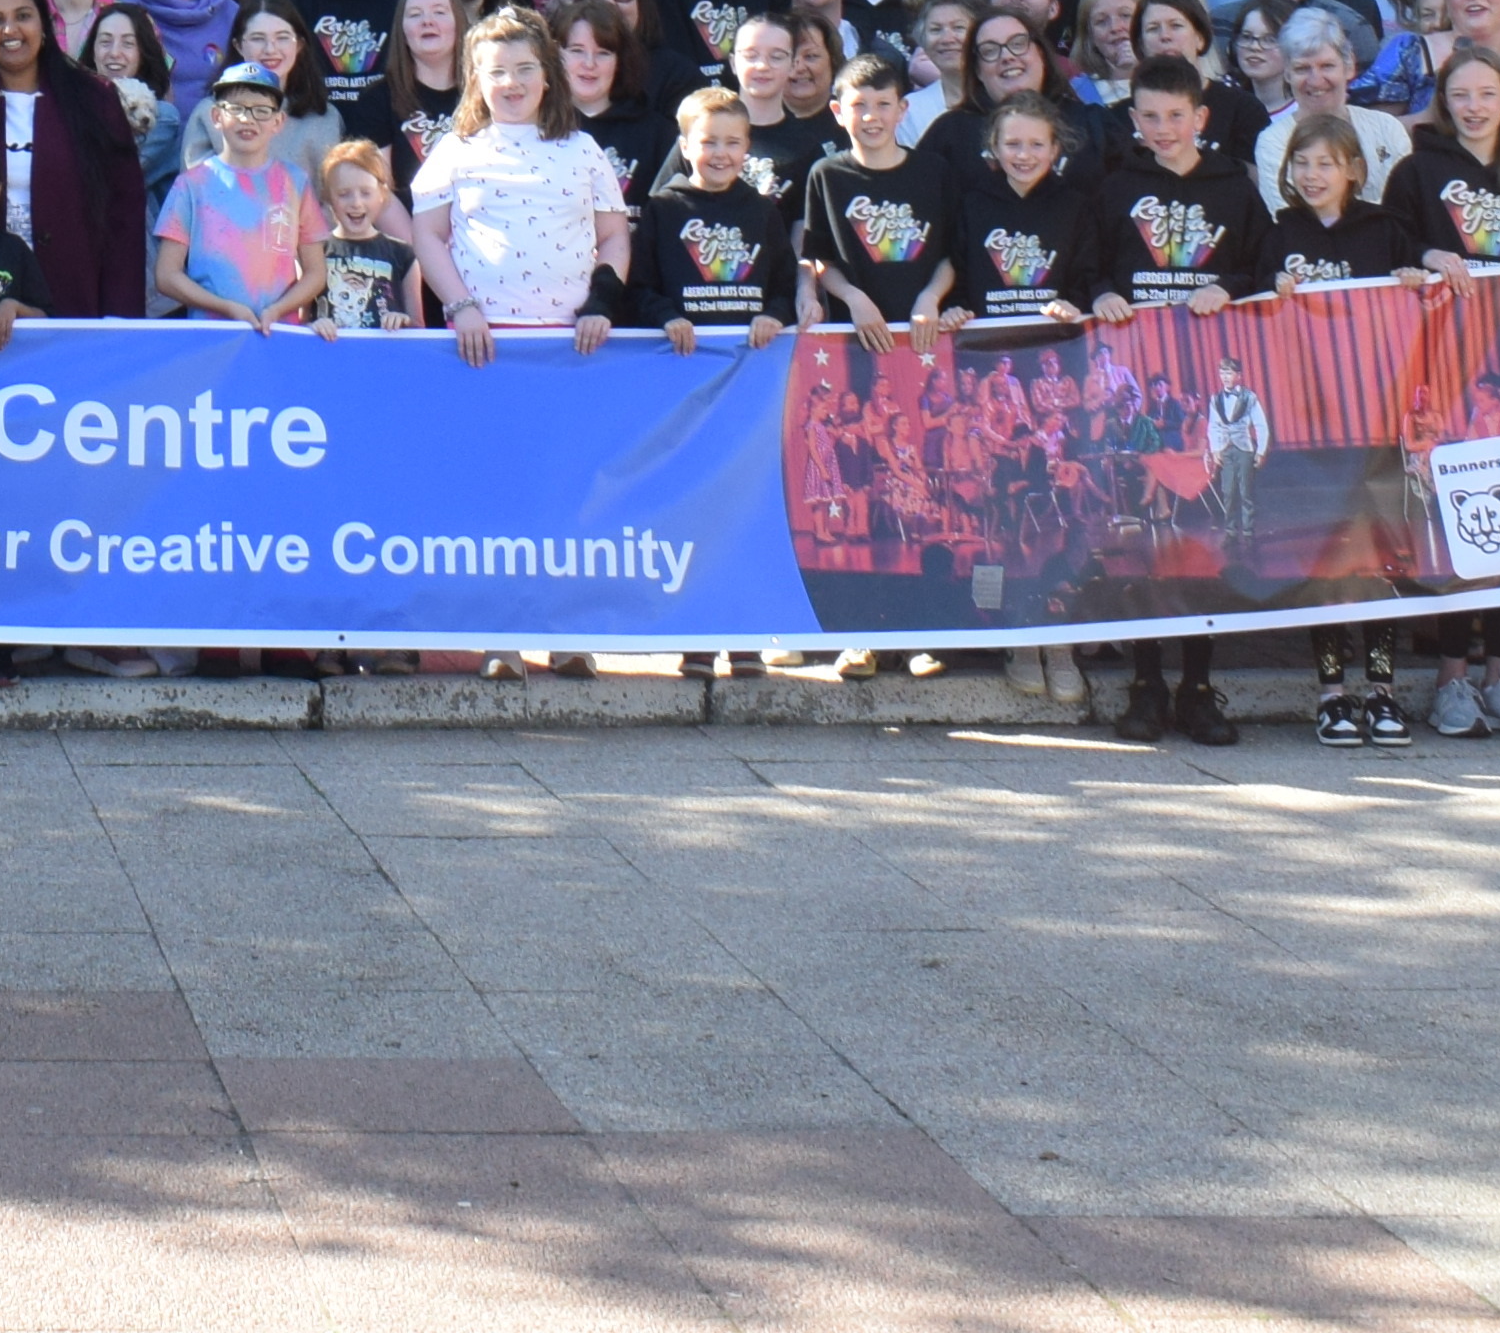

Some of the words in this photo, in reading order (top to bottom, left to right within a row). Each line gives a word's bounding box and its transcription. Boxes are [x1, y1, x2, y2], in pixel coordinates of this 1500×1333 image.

[1173, 273, 1194, 285] ARTS
[720, 285, 738, 298] ARTS
[49, 519, 310, 574] Creative
[332, 521, 695, 595] Community
